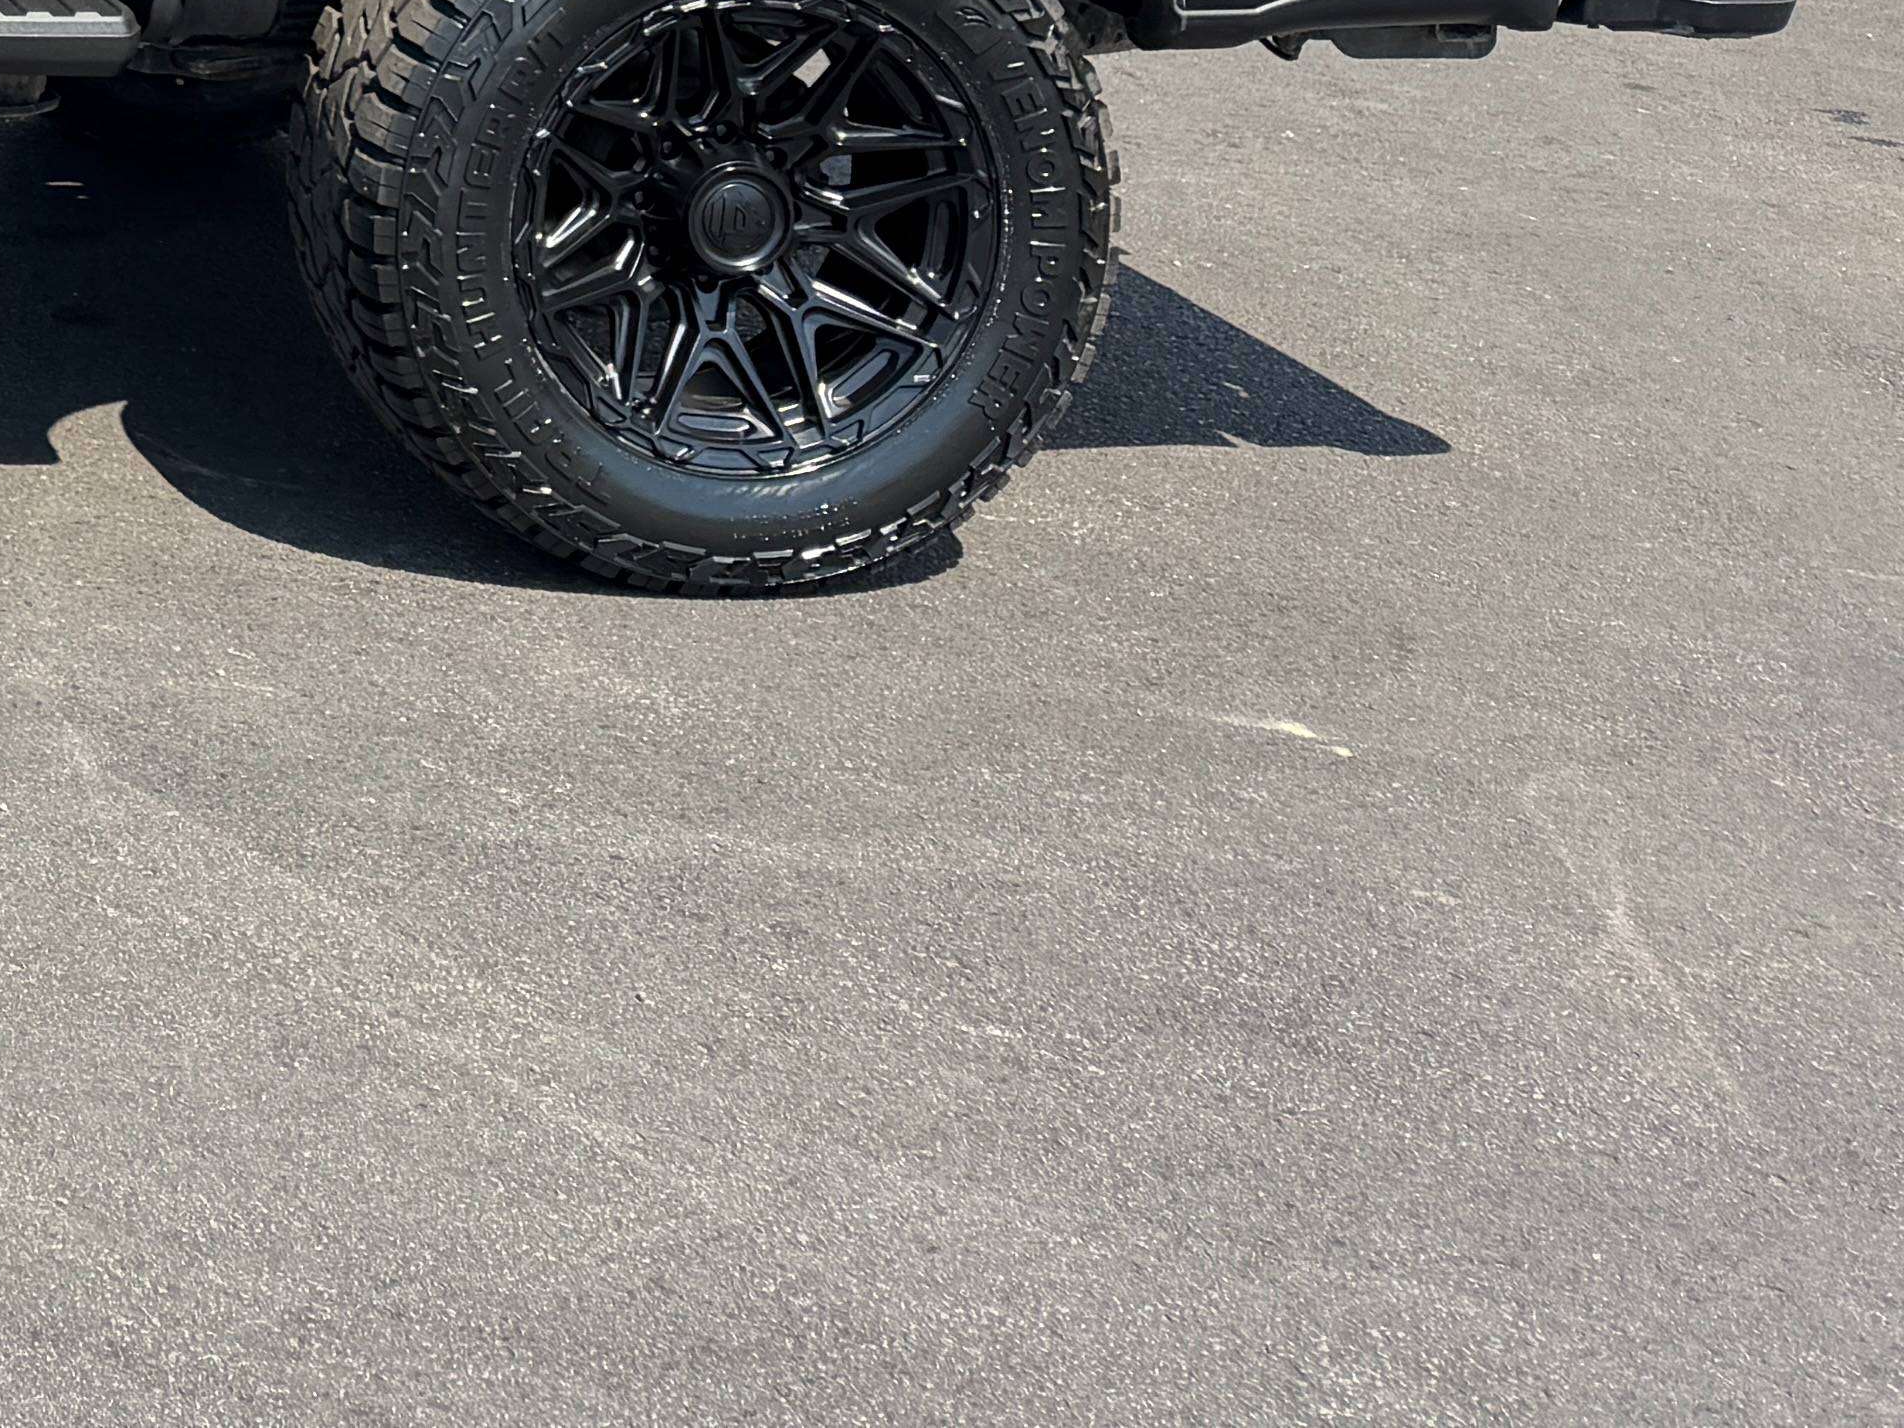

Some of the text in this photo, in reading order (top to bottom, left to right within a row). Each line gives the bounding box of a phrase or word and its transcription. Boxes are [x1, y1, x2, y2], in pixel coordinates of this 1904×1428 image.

[454, 101, 509, 362] HUNTER
[968, 56, 1066, 420] VENOM POWER
[493, 357, 610, 505] TRAIL
